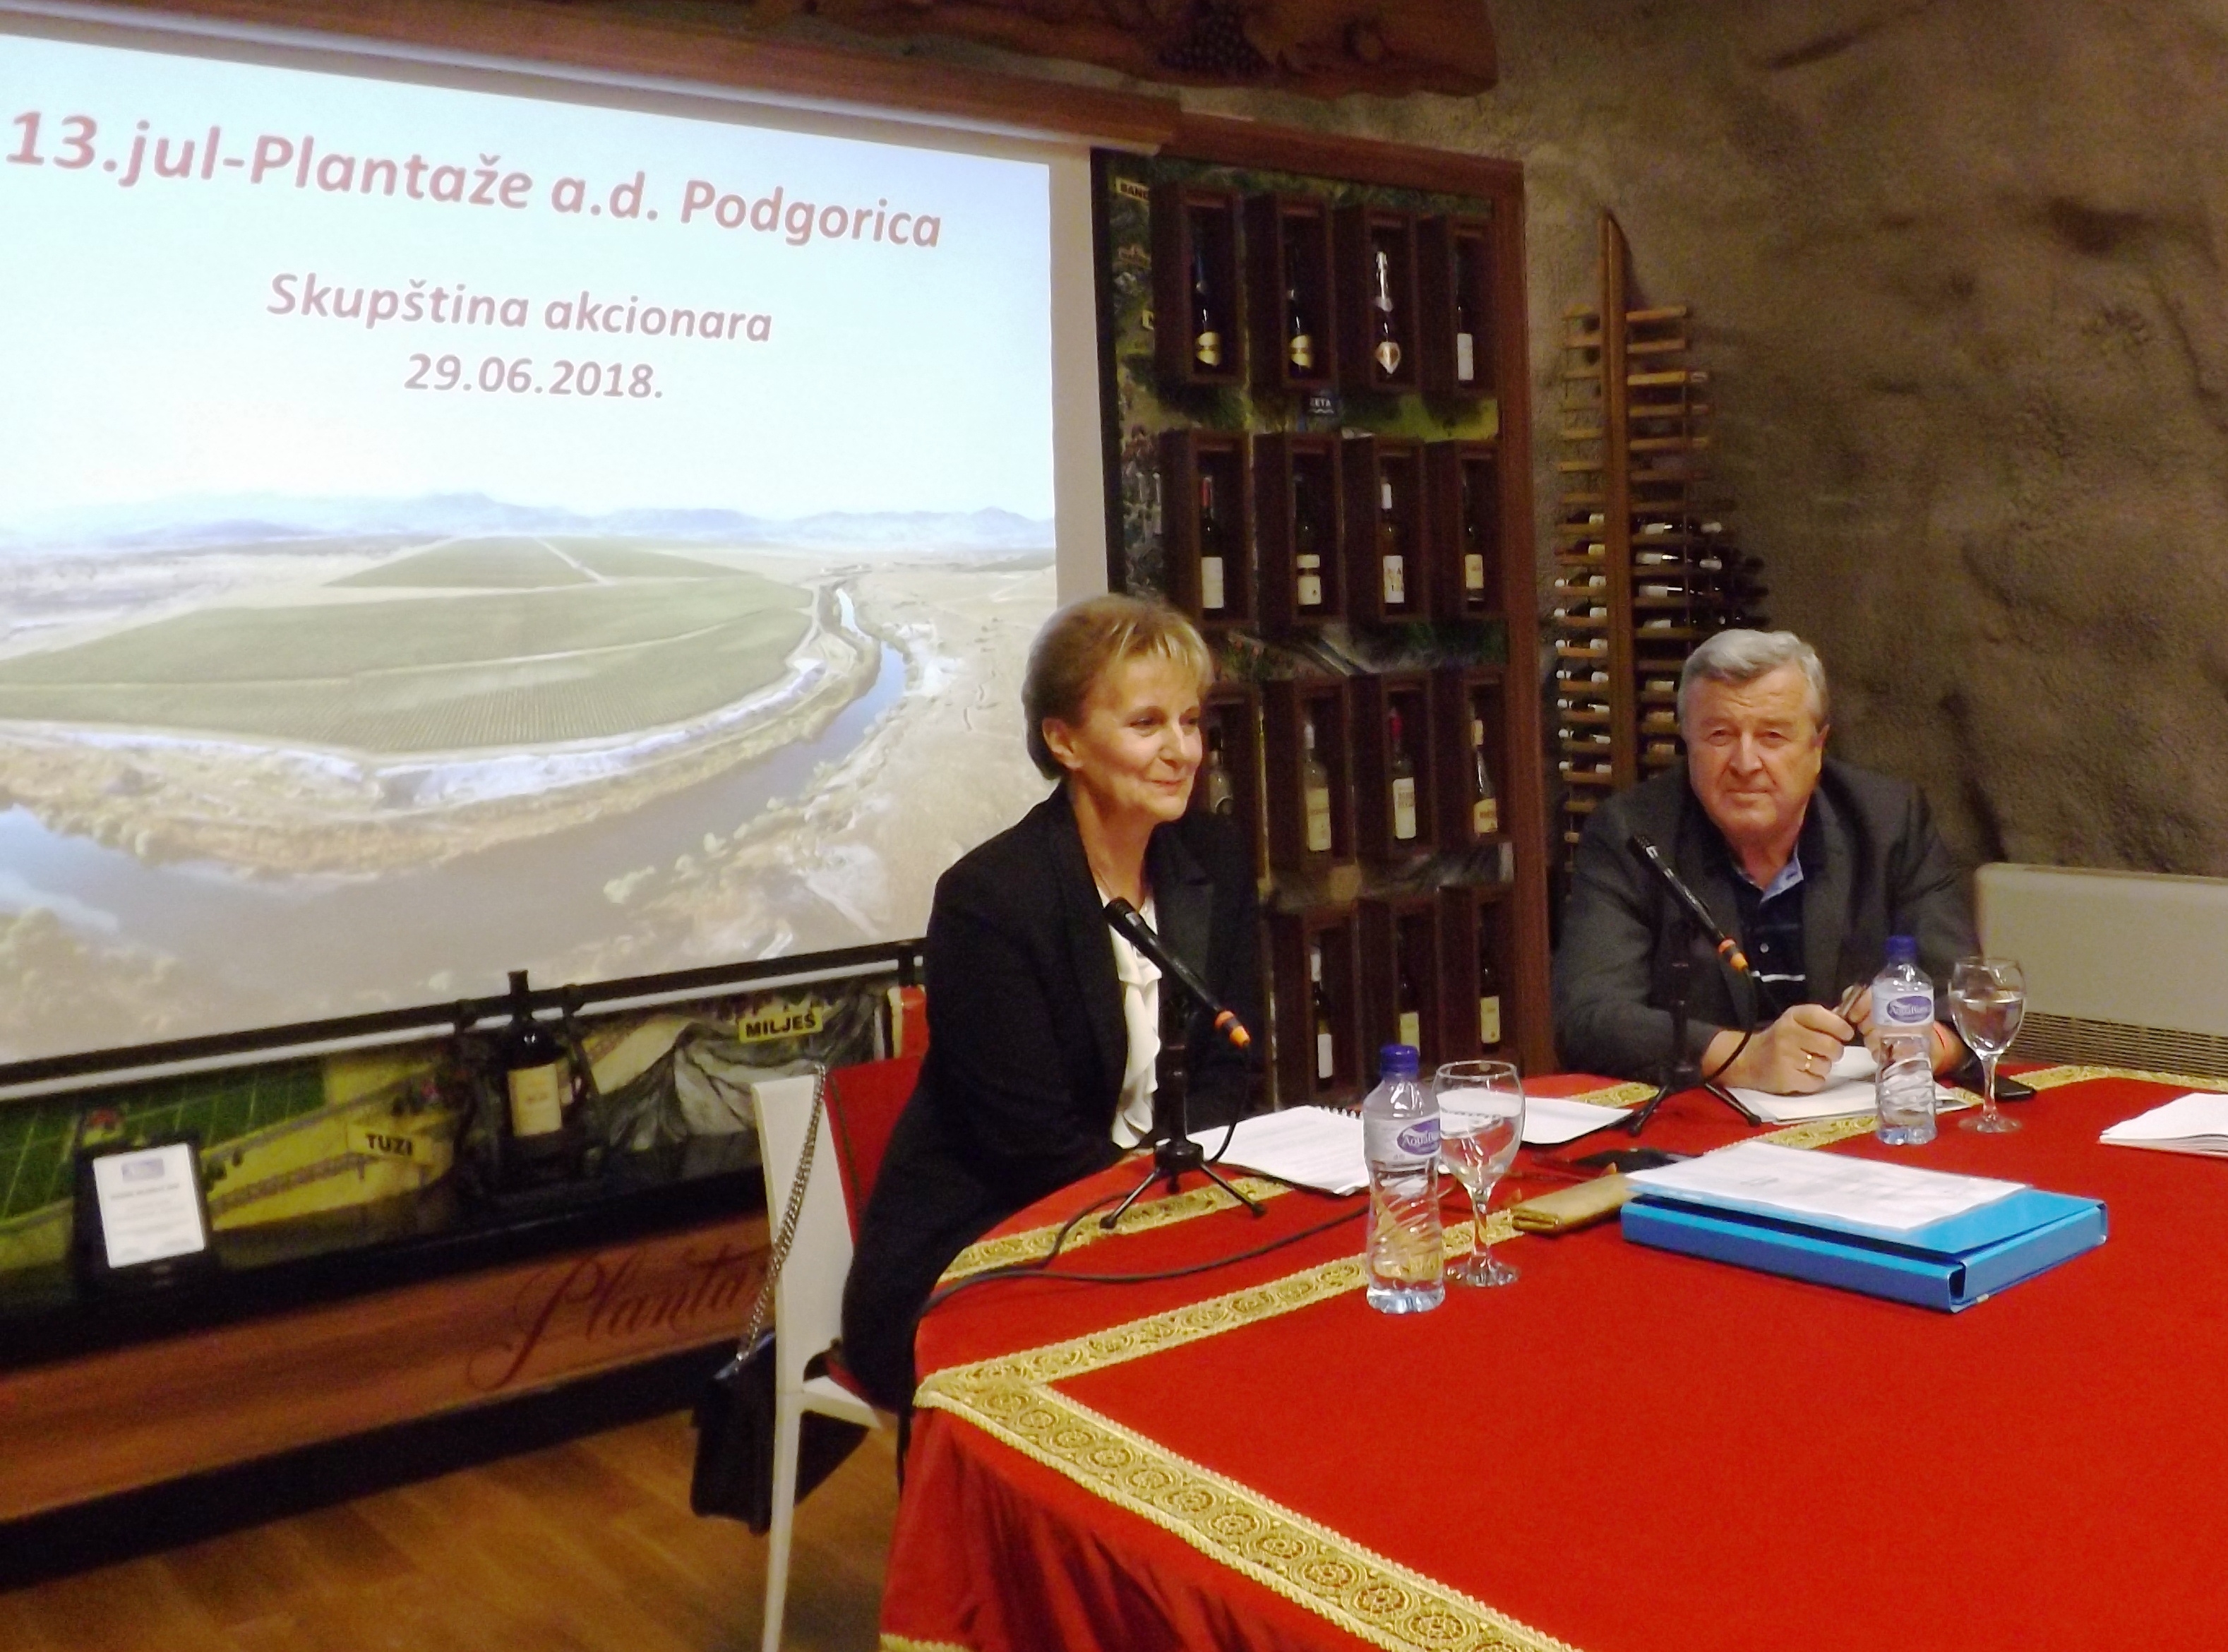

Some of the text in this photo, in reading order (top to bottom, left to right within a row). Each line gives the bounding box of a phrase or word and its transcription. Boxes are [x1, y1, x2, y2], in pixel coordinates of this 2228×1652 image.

[6, 110, 942, 247] 13.jul-Plantaže a.d. Podgorica
[266, 273, 773, 342] Skupština akcionara
[405, 354, 664, 399] 29.06.2018.
[366, 1134, 412, 1156] TUZI
